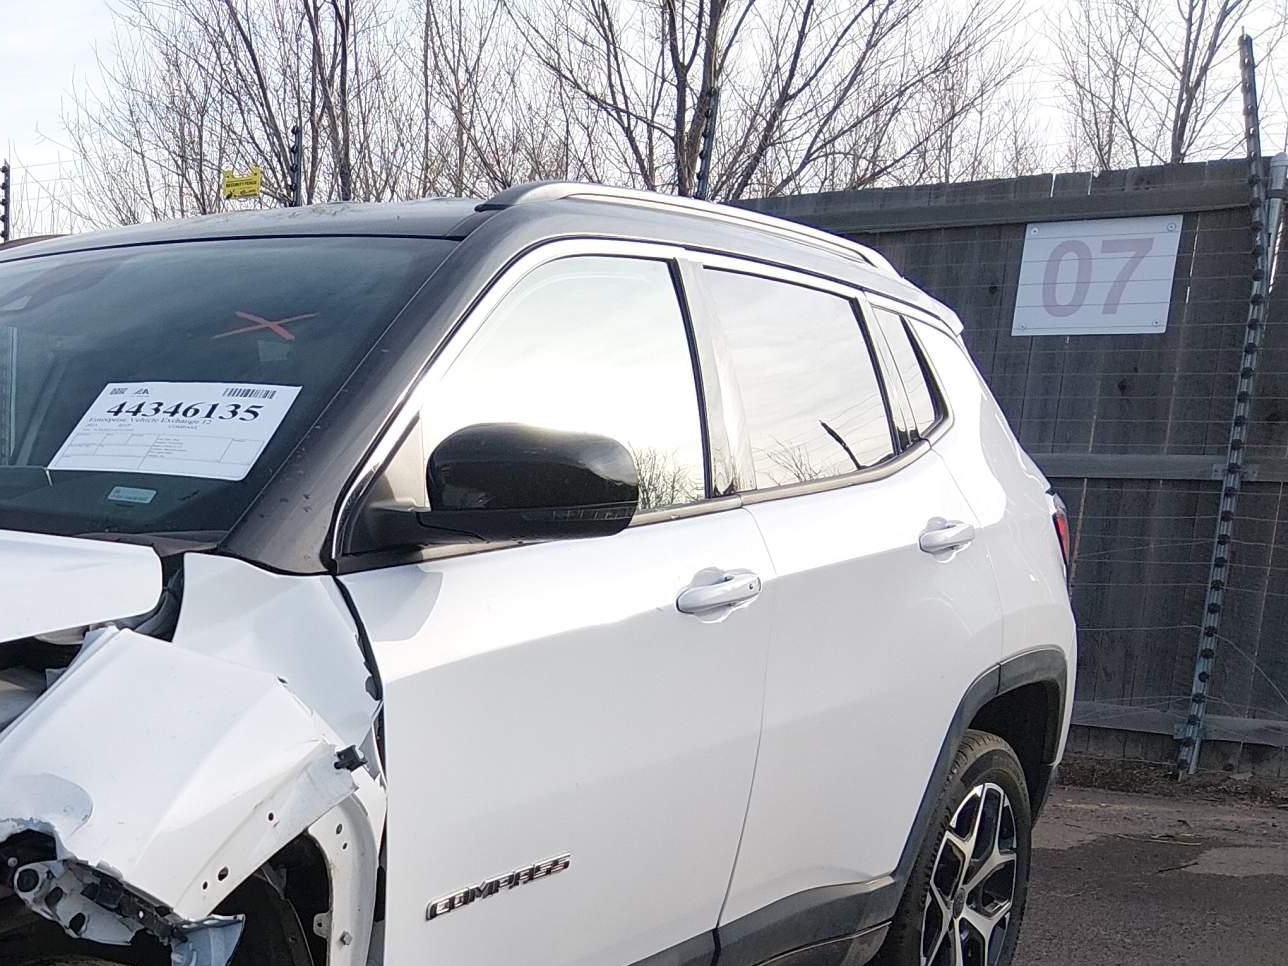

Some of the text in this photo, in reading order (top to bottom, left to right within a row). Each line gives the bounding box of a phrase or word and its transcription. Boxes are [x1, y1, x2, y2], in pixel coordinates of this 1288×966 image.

[1041, 237, 1155, 318] 07
[106, 400, 265, 421] 44346135
[425, 852, 572, 922] COMPASS
